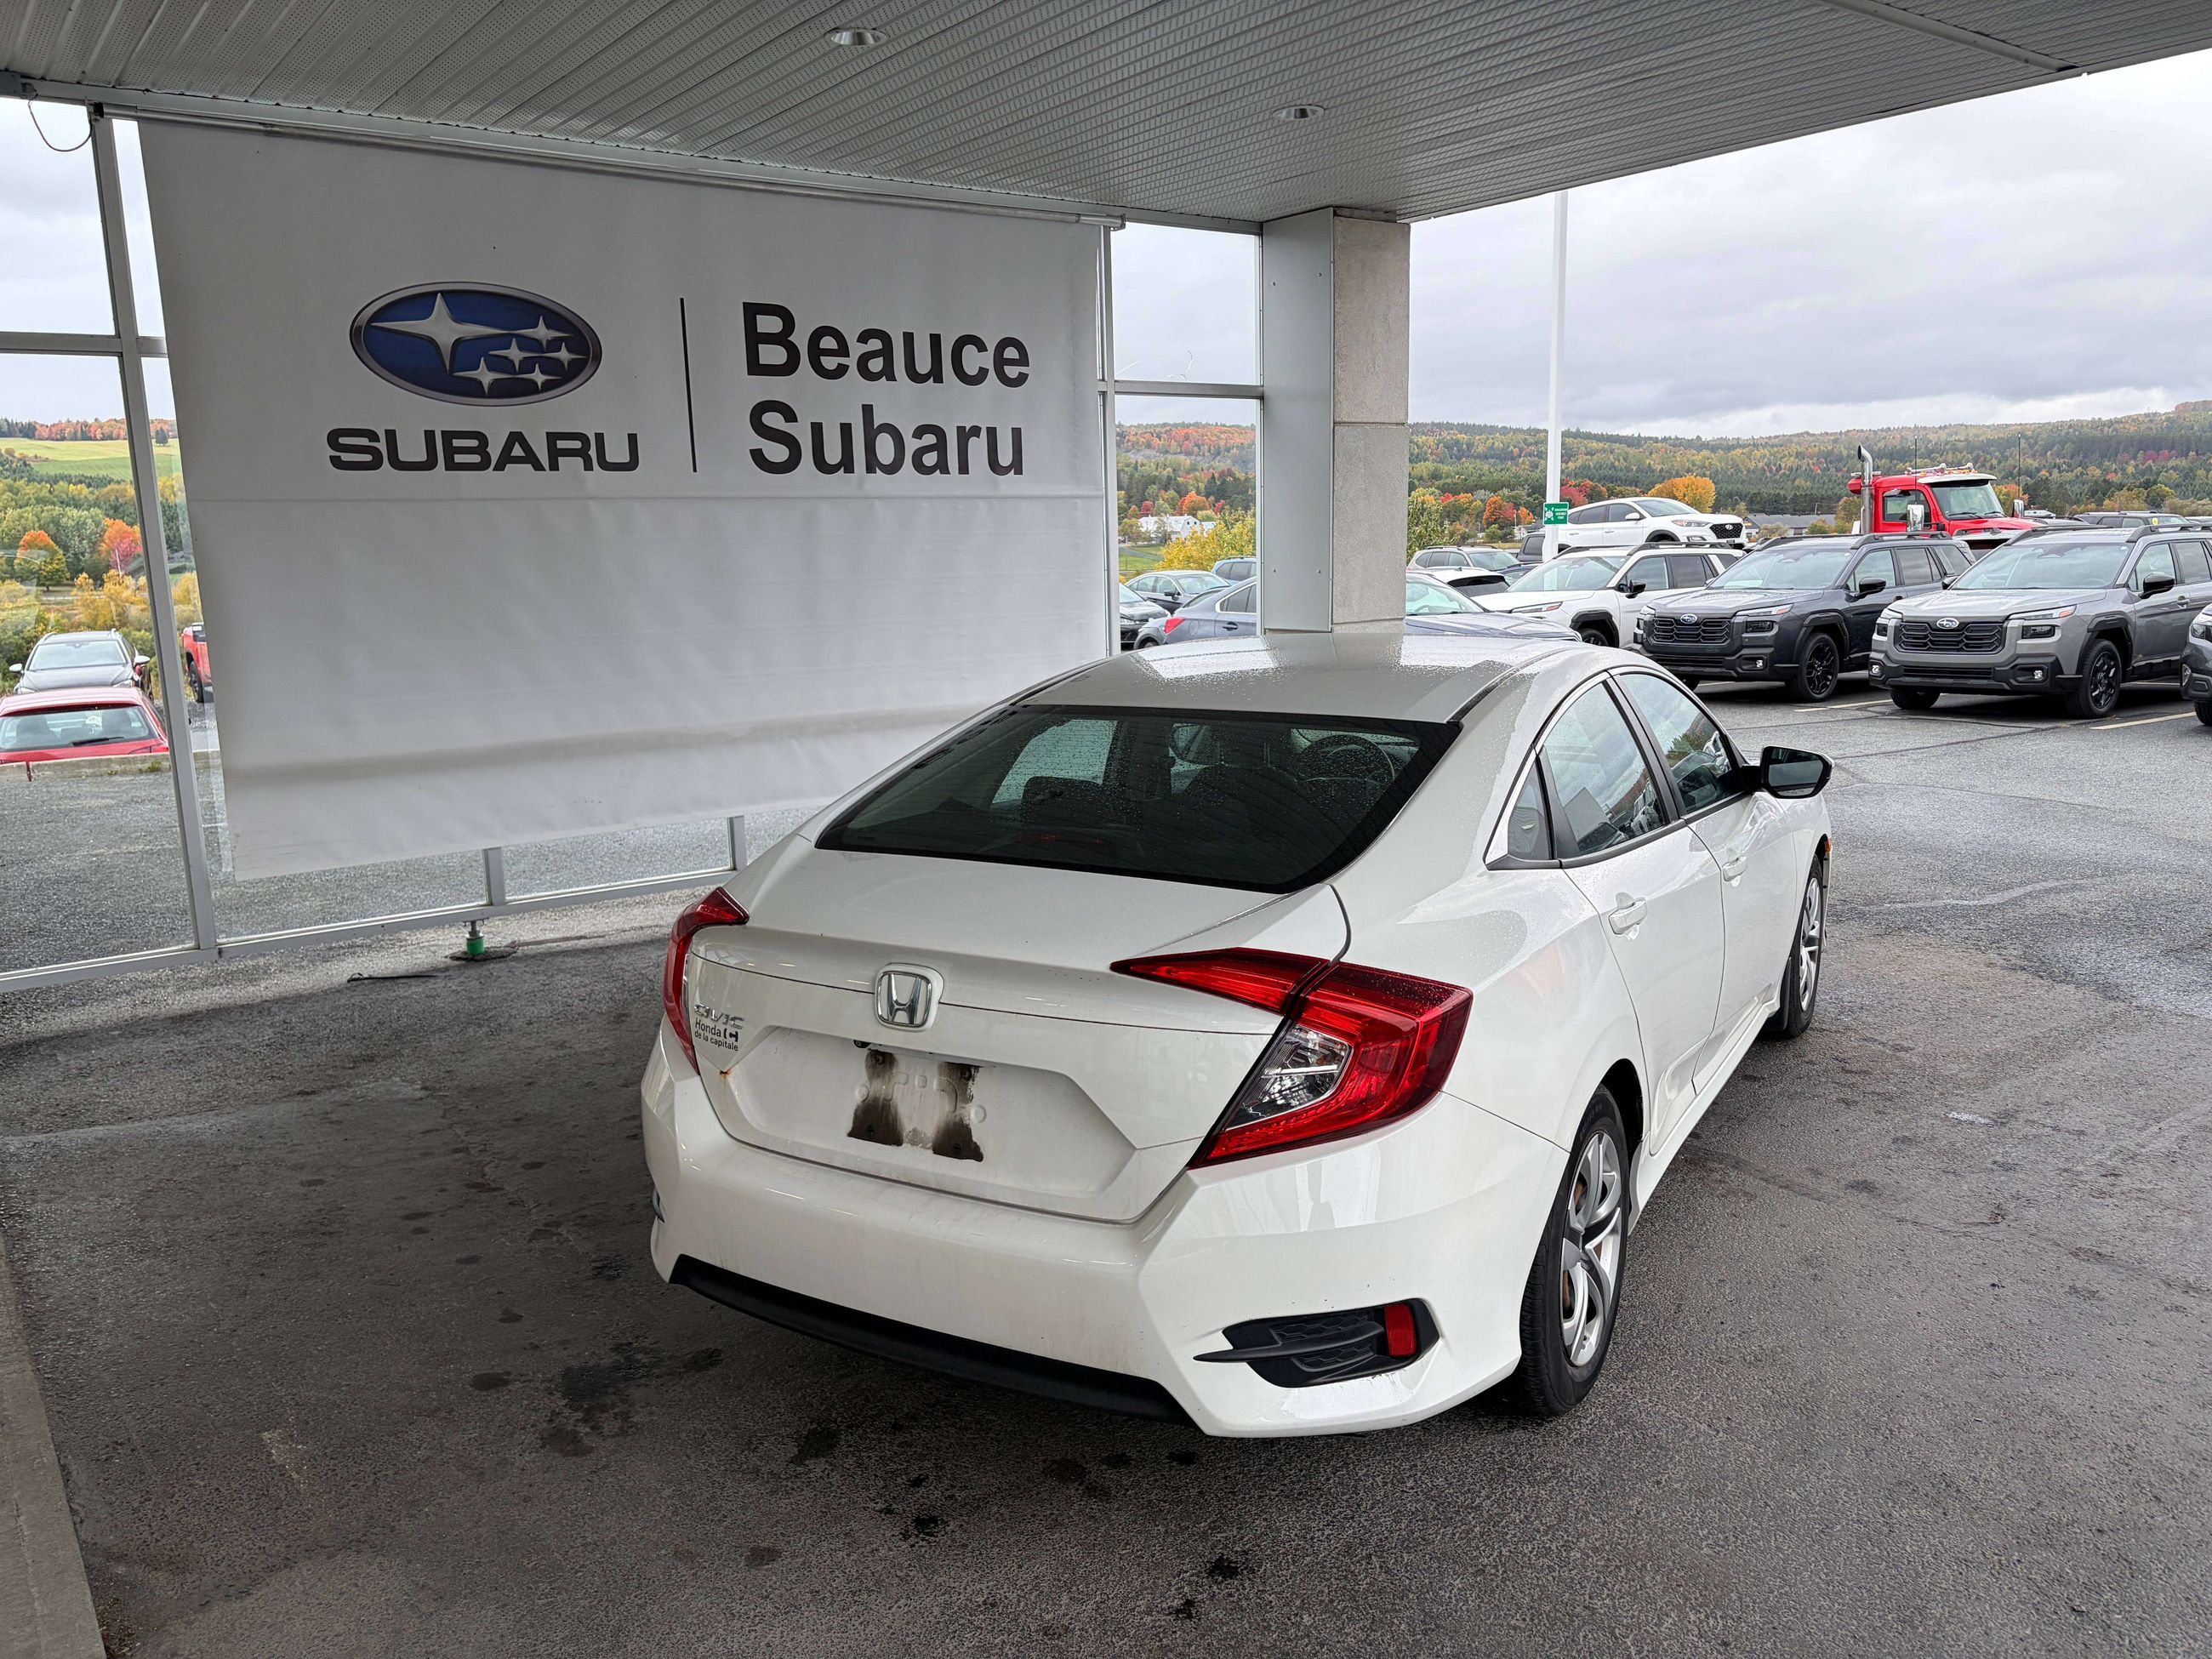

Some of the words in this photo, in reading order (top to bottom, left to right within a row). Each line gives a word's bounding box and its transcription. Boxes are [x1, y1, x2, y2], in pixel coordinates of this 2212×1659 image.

[743, 302, 1029, 388] Beauce
[327, 427, 639, 471] SUBARU
[750, 400, 1023, 476] Subaru
[694, 1029, 702, 1039] de
[703, 1032, 709, 1041] la
[710, 1036, 738, 1052] capitale
[695, 1018, 721, 1037] Honda
